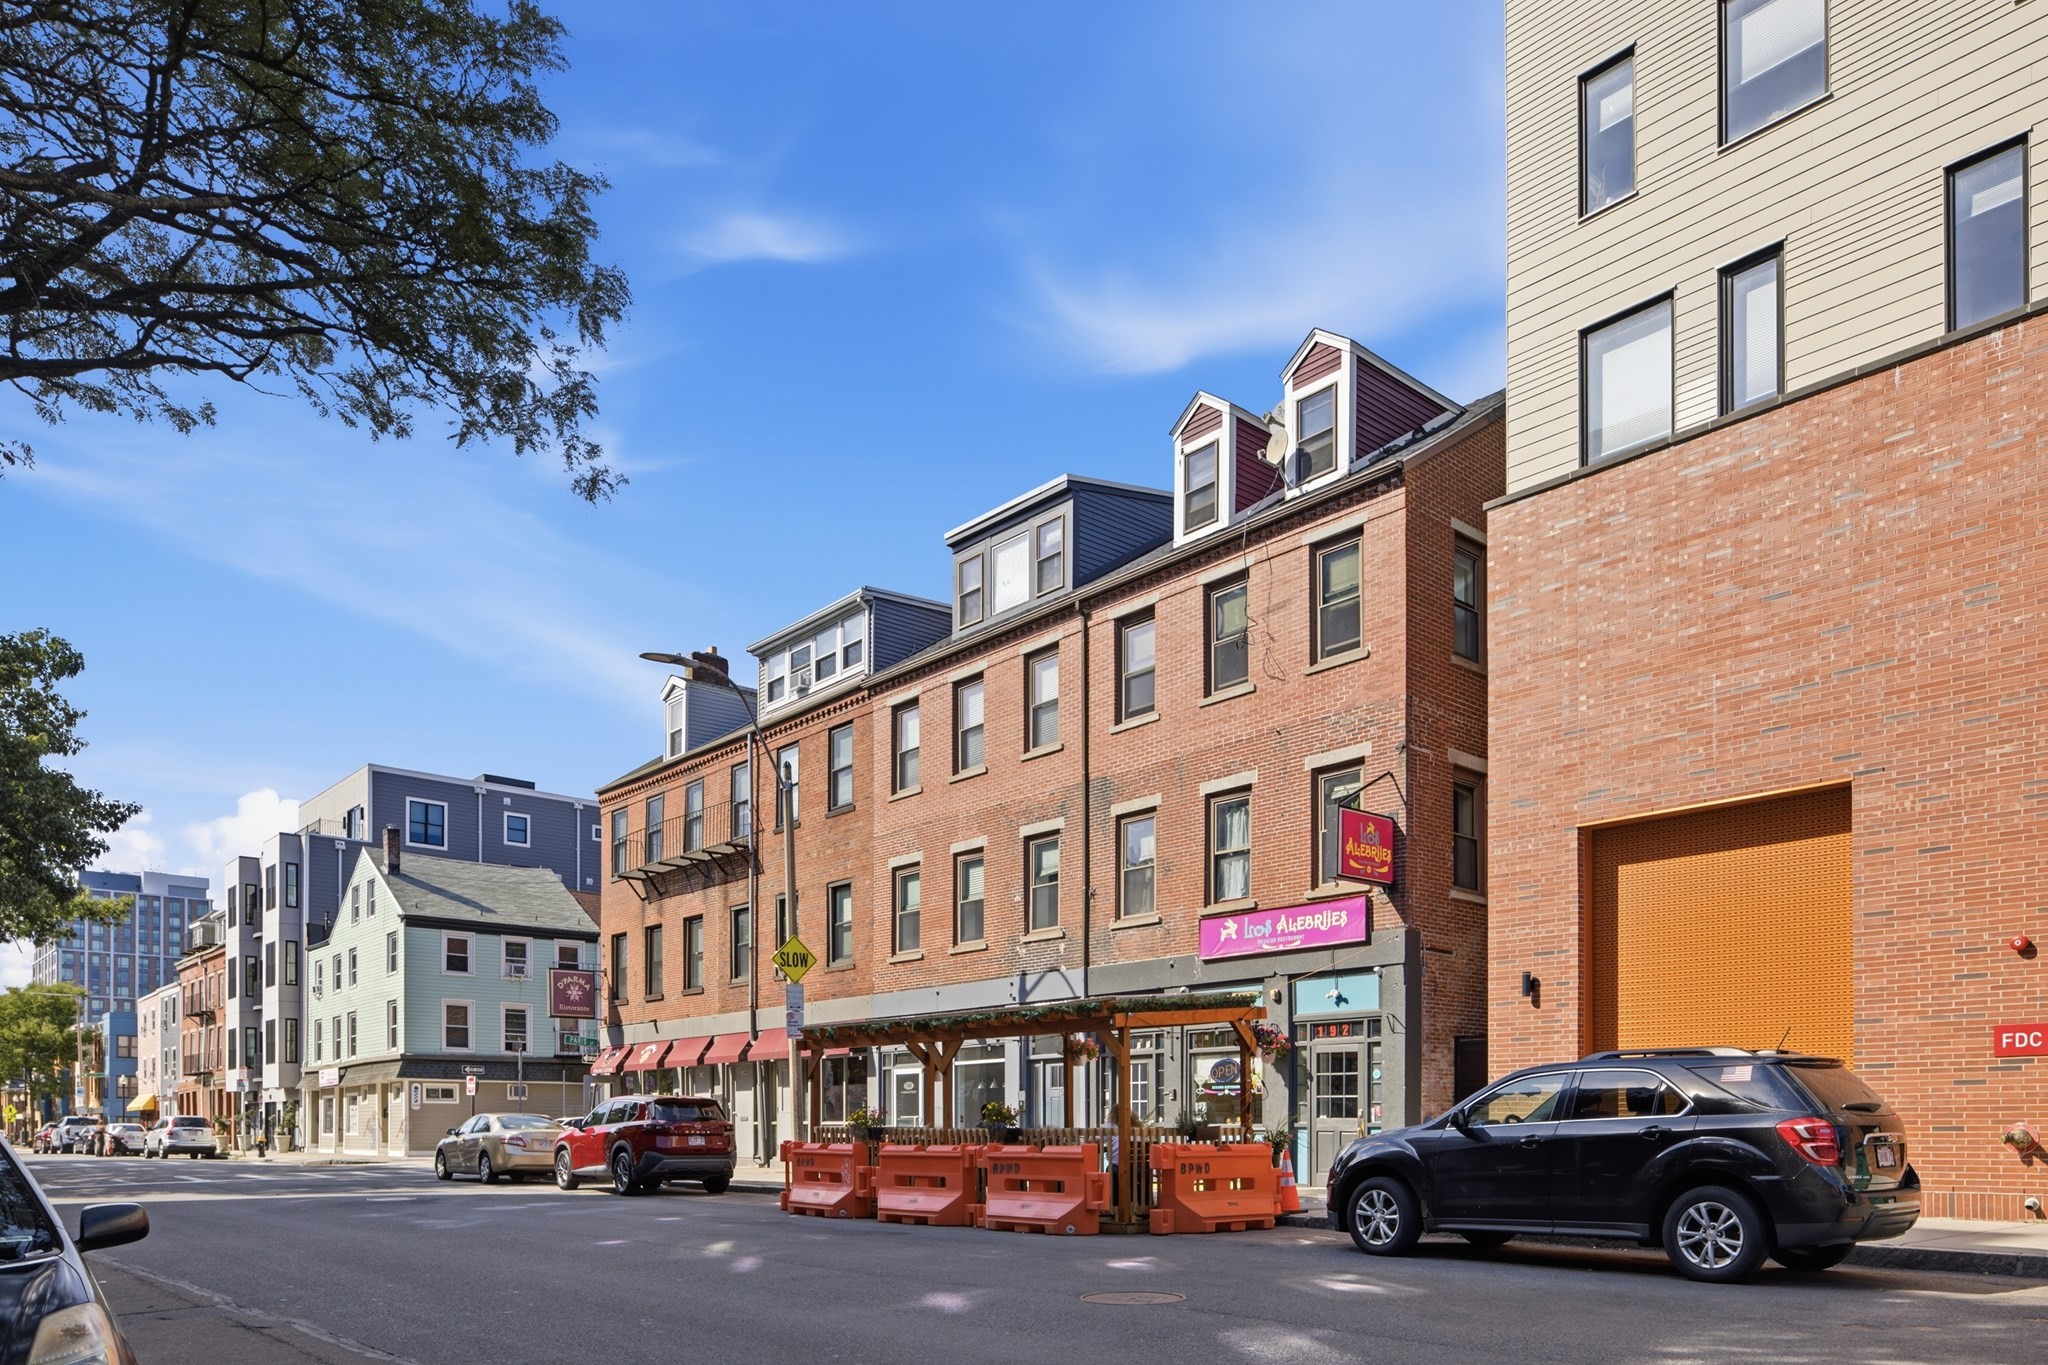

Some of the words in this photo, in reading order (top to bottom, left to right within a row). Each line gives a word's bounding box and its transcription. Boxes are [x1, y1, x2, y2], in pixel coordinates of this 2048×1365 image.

[1346, 837, 1392, 864] ALEBRIJES
[1276, 910, 1348, 934] ALEBRIJES
[780, 952, 808, 968] SLOW
[557, 976, 591, 991] D'PARMA
[1317, 1024, 1350, 1038] 192
[569, 1036, 587, 1045] PARIS
[2002, 1031, 2042, 1048] FDC
[1211, 1063, 1238, 1079] OPEN
[992, 1163, 1021, 1174] BPWD
[1180, 1162, 1211, 1175] BPWD
